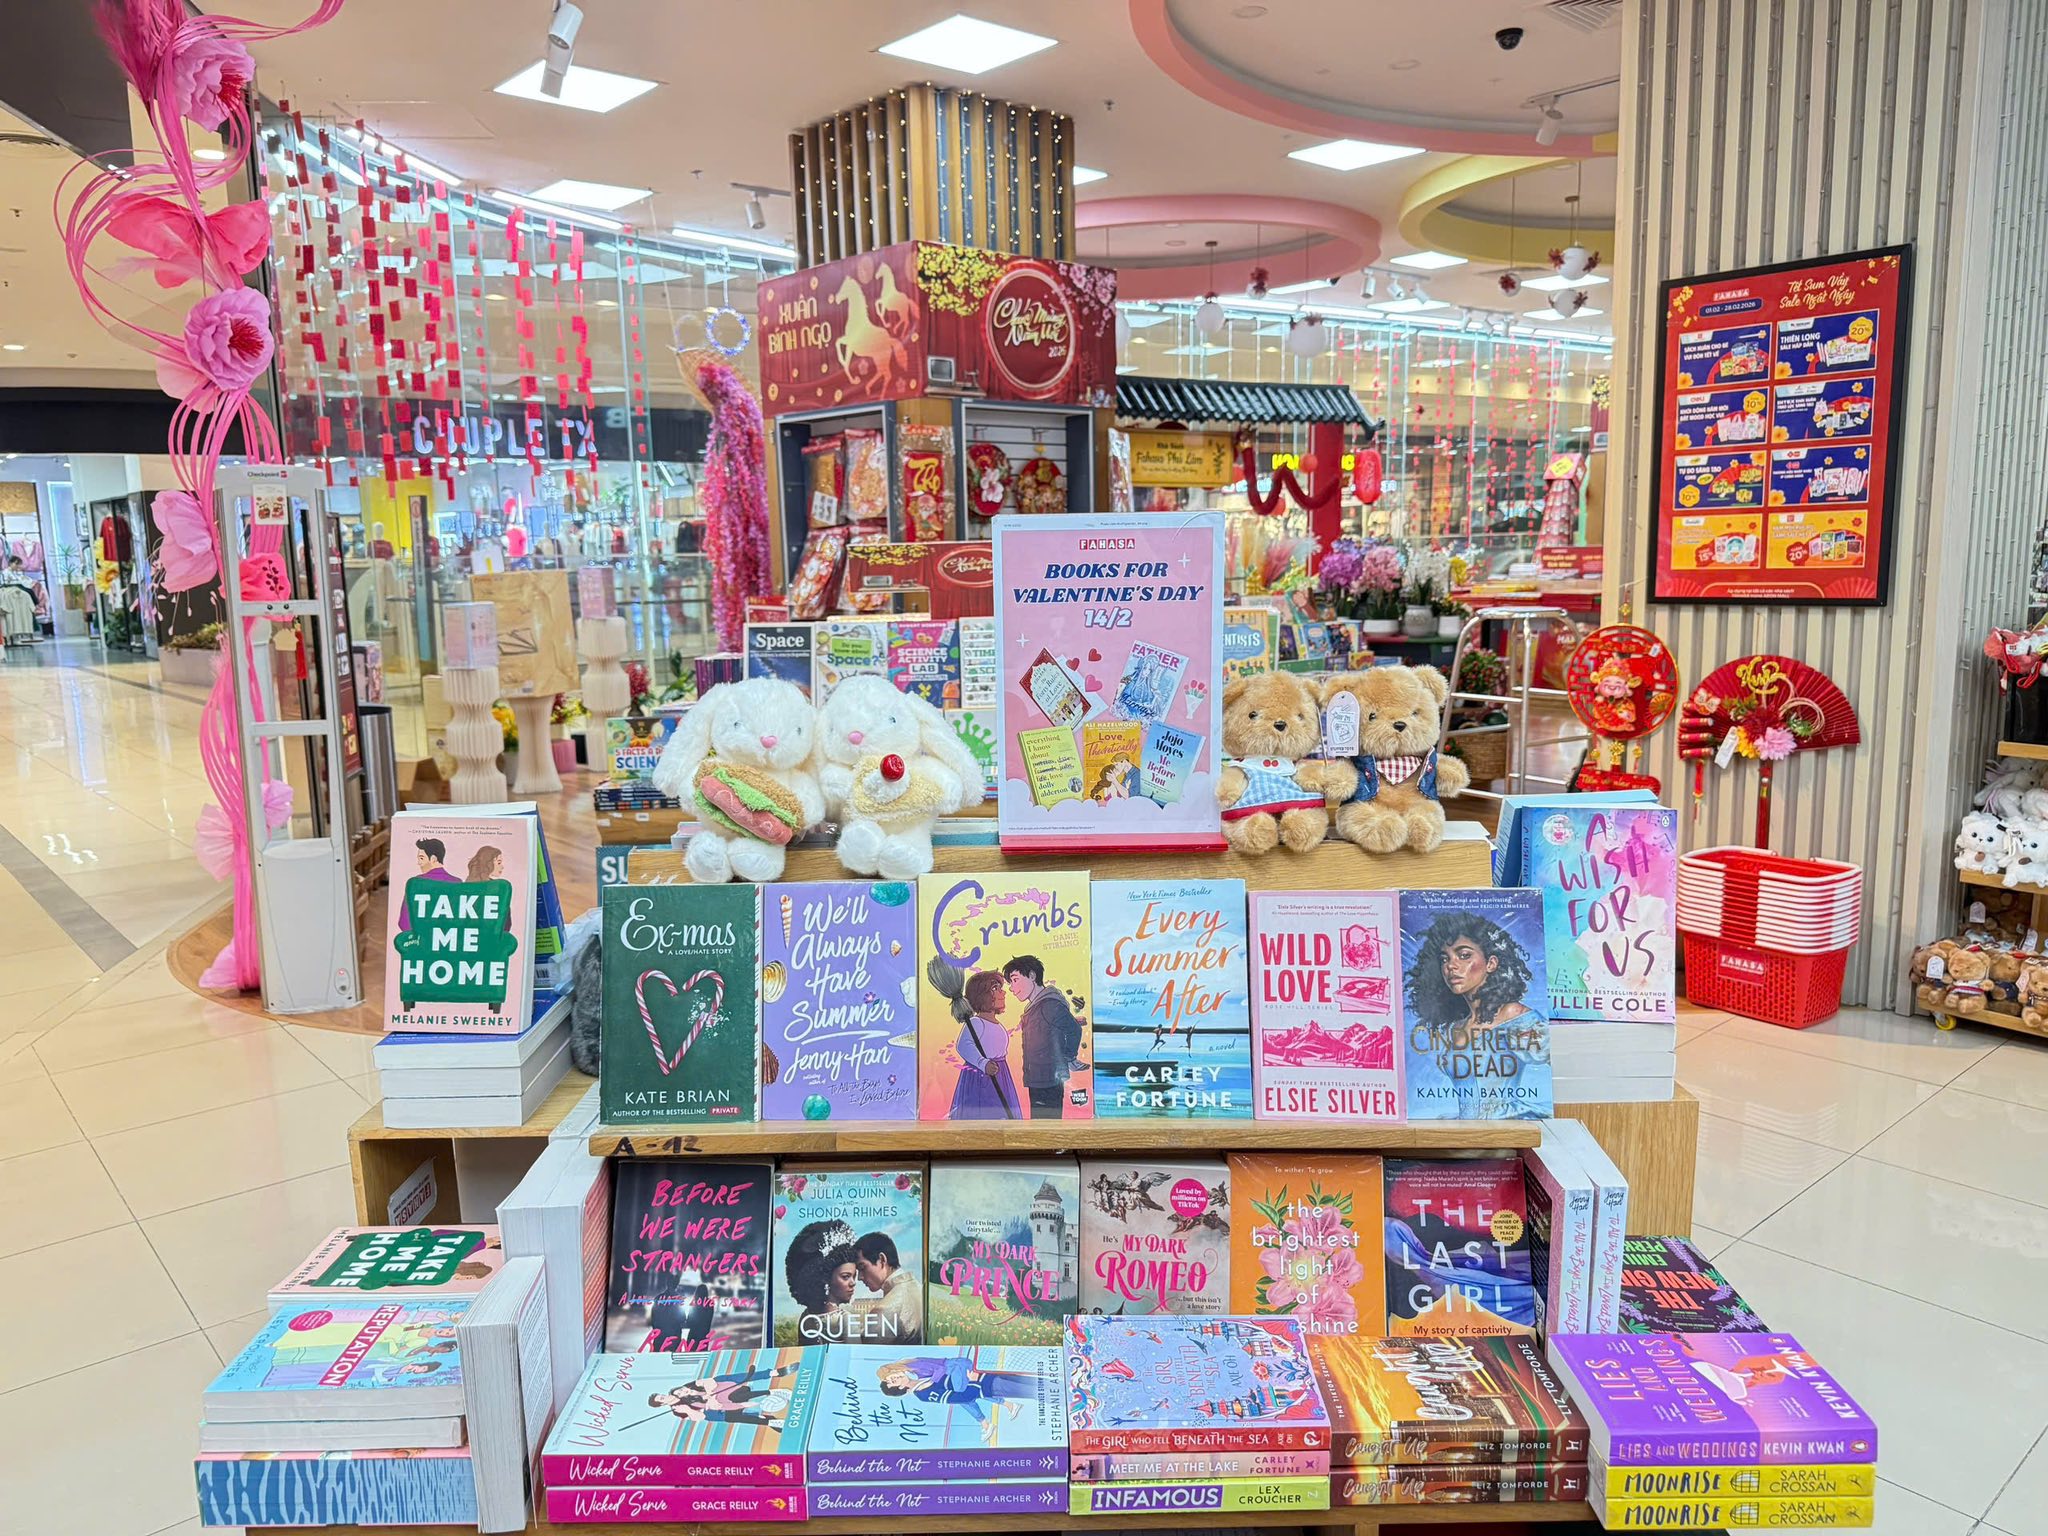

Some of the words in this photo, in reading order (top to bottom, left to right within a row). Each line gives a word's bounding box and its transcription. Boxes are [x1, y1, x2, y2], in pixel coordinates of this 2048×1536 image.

[1801, 332, 1821, 343] LONG
[247, 470, 280, 479] Checkpoint
[1079, 538, 1136, 550] FAHASA
[1044, 563, 1120, 580] BOOKS
[1123, 561, 1169, 579] FOR
[1012, 586, 1154, 604] VALENTINE'S
[1156, 585, 1205, 602] DAY
[1083, 607, 1133, 630] 14/2
[755, 632, 805, 650] Space
[898, 647, 948, 657] SCIENCE
[827, 653, 881, 668] Space?
[898, 655, 947, 664] ACTIVITY
[911, 664, 936, 674] LAB
[1154, 739, 1185, 759] Moyes
[1147, 759, 1176, 779] Before
[1585, 812, 1609, 851] A
[1558, 825, 1650, 892] WISH
[414, 893, 500, 920] TAKE
[803, 894, 869, 933] We'll
[1568, 885, 1637, 937] FOR
[620, 897, 736, 953] Ex-mas
[932, 879, 1083, 967] Crumbs
[1134, 901, 1229, 948] Every
[431, 927, 480, 952] ME
[791, 931, 882, 970] Always
[1260, 932, 1332, 967] WILD
[1105, 936, 1239, 977] Summer
[1602, 929, 1656, 977] US
[402, 959, 505, 986] HOME
[804, 967, 872, 1008] Have
[1263, 969, 1332, 1003] LOVE
[1150, 973, 1232, 1035] After
[1612, 997, 1667, 1013] COLE
[391, 1014, 447, 1025] MELANIE
[453, 1015, 512, 1026] SWEENEY
[783, 1000, 895, 1042] Summer
[1410, 1025, 1542, 1055] CINDERELLA
[783, 1046, 844, 1084] Jenny
[843, 1043, 891, 1081] Han
[1125, 1066, 1222, 1083] CARLEY
[1436, 1053, 1449, 1067] IS
[1452, 1054, 1519, 1080] DEAD
[624, 1090, 668, 1105] KATE
[676, 1089, 731, 1103] BRIAN
[1116, 1091, 1232, 1108] FORTUNE
[1265, 1087, 1319, 1113] ELSIE
[1328, 1088, 1397, 1116] SILVER
[1416, 1087, 1473, 1098] KALYNN
[1480, 1087, 1538, 1098] BAYRON
[651, 1179, 754, 1208] BEFORE
[811, 1188, 842, 1200] JULIA
[848, 1187, 887, 1199] QUINN
[1175, 1187, 1195, 1195] Loved
[1195, 1188, 1203, 1196] by
[798, 1207, 848, 1219] SHONDA
[853, 1205, 898, 1217] RHIMES
[1177, 1200, 1200, 1209] TikTok
[1286, 1198, 1324, 1219] the
[1412, 1198, 1493, 1227] THE
[639, 1213, 677, 1241] WE
[684, 1216, 753, 1241] WERE
[1252, 1226, 1361, 1251] brightest
[1102, 1235, 1119, 1243] He's
[1122, 1234, 1145, 1254] MY
[1145, 1233, 1189, 1260] DARK
[330, 1233, 394, 1287] HOME
[380, 1246, 416, 1273] ME
[408, 1235, 464, 1282] TAKE
[621, 1249, 760, 1276] STRANGERS
[971, 1240, 995, 1264] MY
[995, 1240, 1039, 1267] DARK
[1402, 1240, 1512, 1271] LAST
[1280, 1255, 1334, 1281] light
[940, 1254, 1061, 1316] PRINCE
[1094, 1250, 1209, 1310] ROMEO
[1296, 1283, 1320, 1305] of
[1408, 1283, 1513, 1313] GIRL
[800, 1312, 899, 1344] QUEEN
[1299, 1313, 1360, 1333] shine
[1413, 1325, 1429, 1337] My
[1431, 1325, 1456, 1337] story
[1458, 1324, 1470, 1335] of
[1471, 1324, 1512, 1337] captivity
[322, 1304, 400, 1385] REPUTATION
[1085, 1436, 1100, 1446] THE
[1102, 1433, 1131, 1450] GIRL
[1131, 1437, 1152, 1445] WHO
[1153, 1435, 1170, 1445] FELL
[1171, 1431, 1225, 1445] BENEATH
[1228, 1434, 1243, 1444] THE
[1247, 1433, 1269, 1445] SEA
[1479, 1442, 1495, 1450] LIZ
[1499, 1442, 1552, 1450] TOMFORDE
[1619, 1443, 1651, 1460] LIES
[1656, 1445, 1675, 1456] AND
[1677, 1441, 1758, 1459] WEDDINGS
[1763, 1441, 1801, 1455] KEVIN
[1807, 1440, 1845, 1454] KWAN
[569, 1457, 621, 1480] Wicked
[623, 1456, 663, 1481] Serve
[687, 1466, 722, 1476] GRACE
[724, 1466, 754, 1476] REILLY
[816, 1458, 867, 1475] Behind
[867, 1458, 892, 1473] the
[896, 1458, 931, 1474] Net
[937, 1460, 990, 1468] STEPHANIE
[993, 1459, 1032, 1468] ARCHER
[1108, 1462, 1141, 1475] MEET
[1143, 1462, 1163, 1473] ME
[1165, 1462, 1182, 1473] AT
[1183, 1461, 1205, 1473] THE
[1207, 1461, 1240, 1472] LAKE
[1249, 1465, 1301, 1474] FORTUNE
[1254, 1455, 1297, 1464] CARLEY
[1624, 1470, 1721, 1494] MOONRISE
[1769, 1481, 1836, 1493] CROSSAN
[1780, 1470, 1827, 1481] SARAH
[1094, 1486, 1219, 1509] INFAMOUS
[1238, 1494, 1302, 1504] CROUCHER
[1258, 1485, 1281, 1494] LEX
